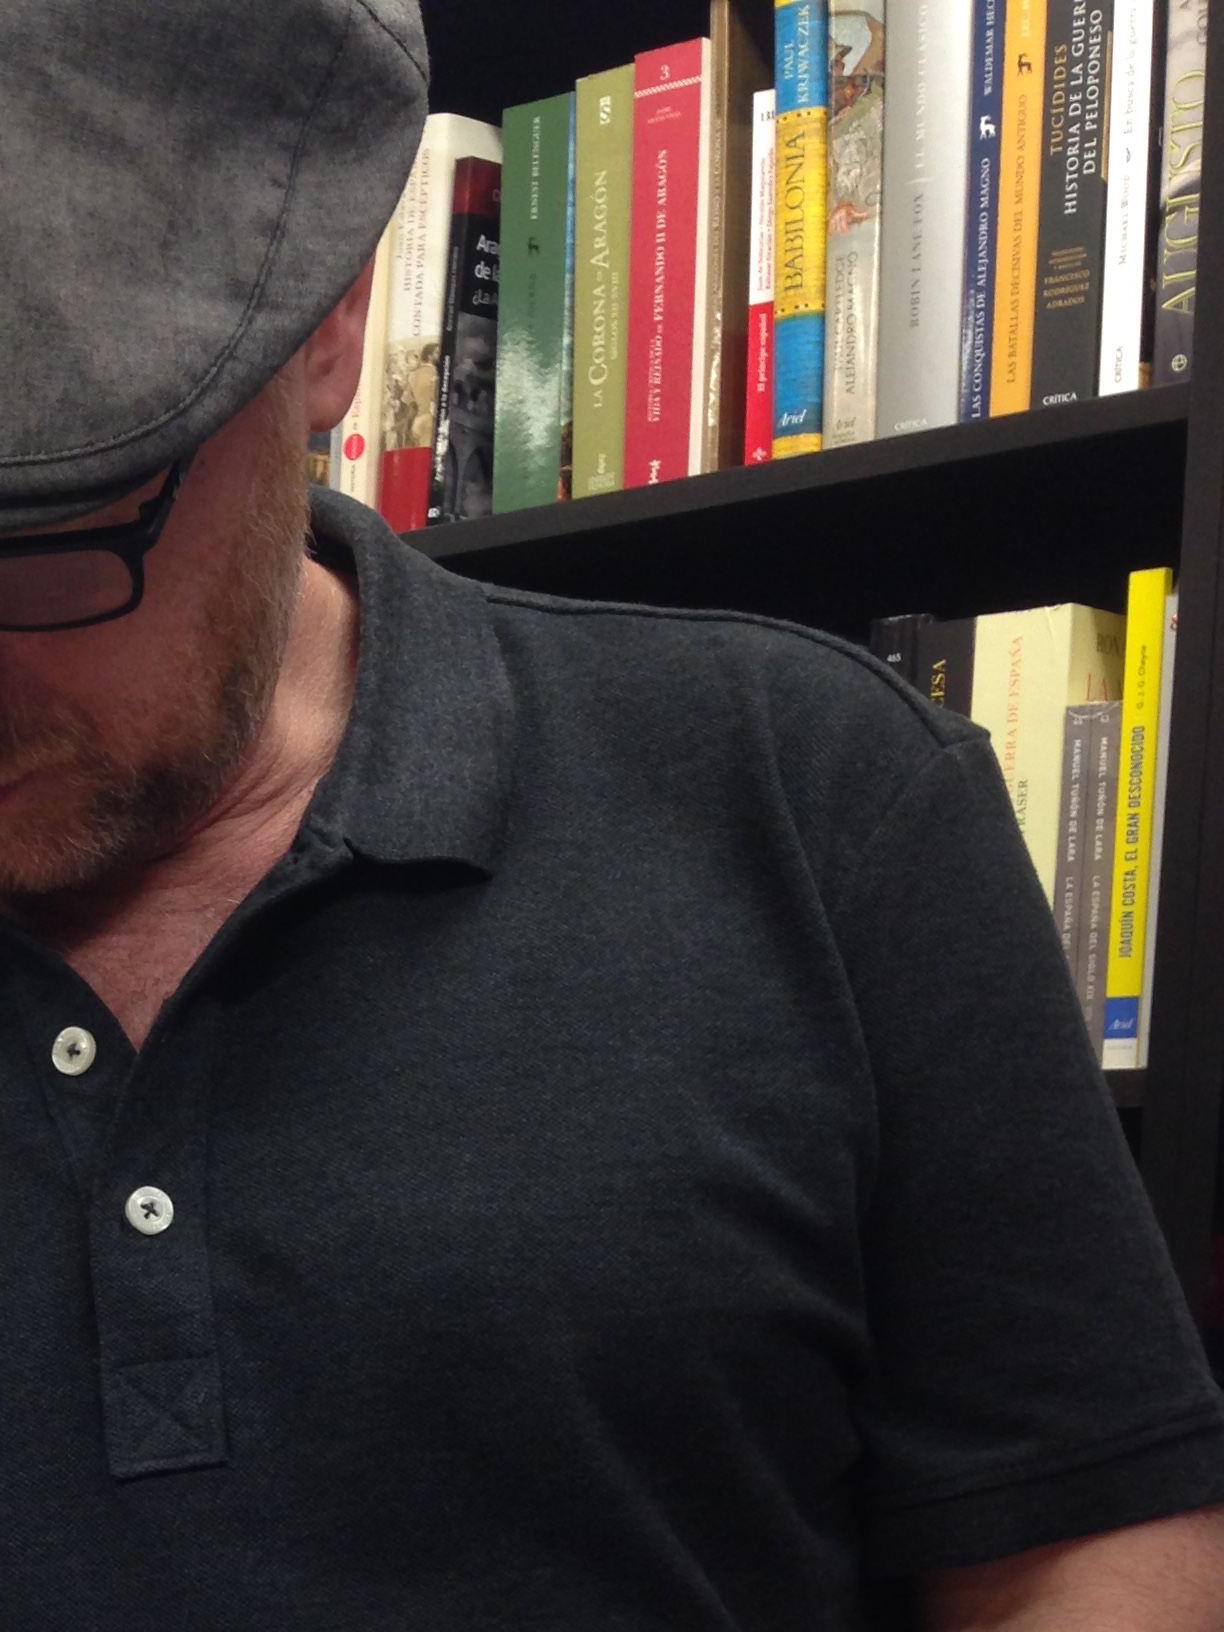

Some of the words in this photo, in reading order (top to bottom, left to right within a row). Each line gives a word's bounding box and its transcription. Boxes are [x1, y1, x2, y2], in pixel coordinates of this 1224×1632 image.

[661, 65, 672, 80] 3
[784, 39, 795, 80] PAUL
[797, 5, 810, 103] KRIWACZEK
[983, 28, 995, 97] WALDEMAR
[1069, 61, 1084, 86] LA
[1084, 9, 1104, 130] PELOPONESO
[1126, 64, 1135, 76] de
[1050, 42, 1068, 155] TUCÍDIDES
[1068, 92, 1084, 115] DE
[1124, 82, 1135, 112] busca
[1015, 94, 1027, 152] ANTIGUO
[1062, 123, 1082, 215] HISTORIA
[1081, 136, 1098, 175] DEL
[657, 148, 669, 206] ARAGÓN
[979, 157, 991, 208] MAGNO
[1013, 155, 1025, 205] MUNDO
[1160, 70, 1206, 316] AUGUSTO
[589, 170, 608, 267] ARAGÓN
[657, 209, 667, 229] DE
[784, 131, 806, 291] BABILONIA
[911, 193, 923, 225] FOX
[1013, 210, 1023, 232] DEL
[416, 233, 426, 267] PARA
[910, 229, 922, 275] LANE
[977, 212, 991, 287] ALEJANDRO
[1010, 233, 1023, 296] DECISIVAS
[654, 245, 666, 321] FERNANDO
[847, 251, 859, 311] MAGNO
[976, 290, 987, 308] DE
[909, 279, 921, 328] ROBIN
[588, 284, 607, 385] CORONA
[757, 314, 768, 344] español
[1008, 299, 1020, 360] BATALLAS
[845, 312, 858, 394] ALEJANDRO
[973, 311, 986, 392] CONQUISTAS
[1113, 345, 1124, 383] CRÍTICA
[757, 382, 766, 393] El
[1007, 361, 1017, 384] LAS
[594, 389, 603, 407] LA
[971, 396, 982, 418] LAS
[1042, 391, 1078, 406] CRÍTICA
[1006, 636, 1025, 698] ESPAÑA
[1006, 703, 1020, 723] DE
[1070, 739, 1082, 779] MANUEL
[1096, 737, 1109, 777] MANUEL
[1127, 726, 1145, 808] DESCONOCIDO
[1068, 782, 1082, 817] TUÑÓN
[1095, 779, 1108, 816] TUÑÓN
[1068, 820, 1078, 831] DE
[1095, 819, 1104, 831] DE
[1125, 813, 1140, 845] GRAN
[1066, 834, 1078, 862] LARA
[1093, 833, 1104, 861] LARA
[1125, 848, 1138, 862] EL
[1065, 876, 1074, 887] LA
[1092, 876, 1102, 886] LA
[1121, 865, 1139, 907] COSTA,
[1062, 889, 1075, 928] ESPAÑA
[1089, 888, 1102, 928] ESPAÑA
[1088, 932, 1099, 949] DEL
[1118, 909, 1136, 958] JOAQUÍN
[1087, 953, 1098, 983] SIGLO
[1086, 985, 1096, 1001] XIX
